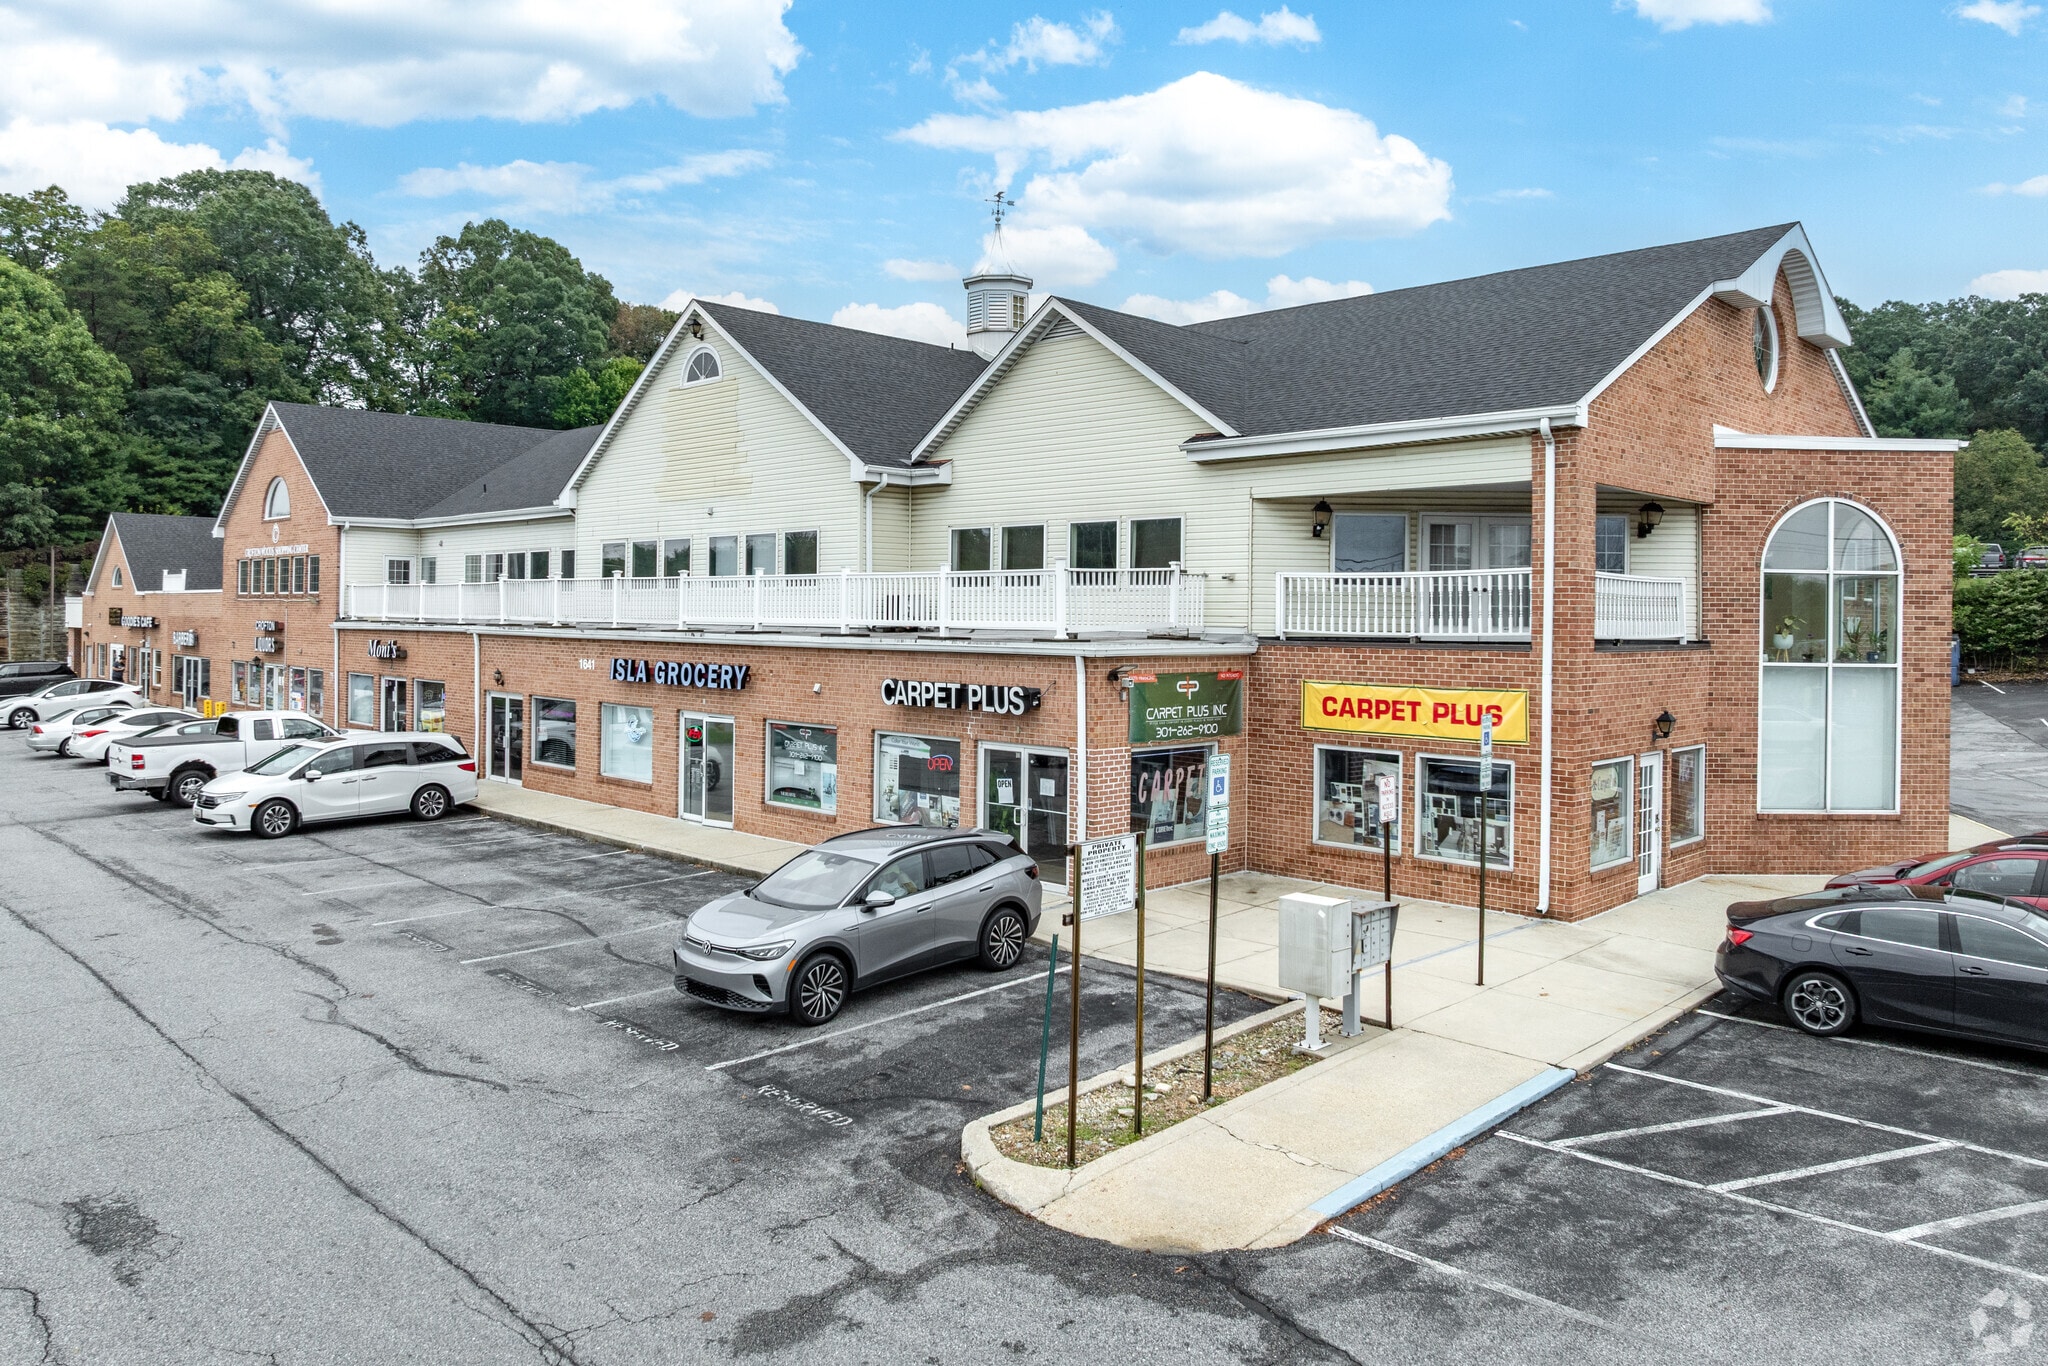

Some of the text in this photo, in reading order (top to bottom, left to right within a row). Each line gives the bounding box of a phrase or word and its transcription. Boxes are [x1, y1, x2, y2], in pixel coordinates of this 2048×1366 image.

[255, 620, 275, 630] CROFTON
[368, 639, 397, 658] Moni's
[579, 659, 595, 670] 1641
[610, 658, 747, 690] ISLA GROCERY
[881, 678, 1025, 715] CARPET PLUS
[1146, 704, 1228, 720] CARPET PLUS INC
[1322, 696, 1421, 722] CARPET
[1432, 702, 1503, 727] PLUS
[1156, 723, 1218, 738] 301-262-9100
[928, 758, 952, 771] OPEN
[998, 780, 1012, 788] OPEN
[1138, 764, 1206, 803] CARPET
[1088, 844, 1126, 856] PROPERTY
[1092, 841, 1121, 850] PRIVATE
